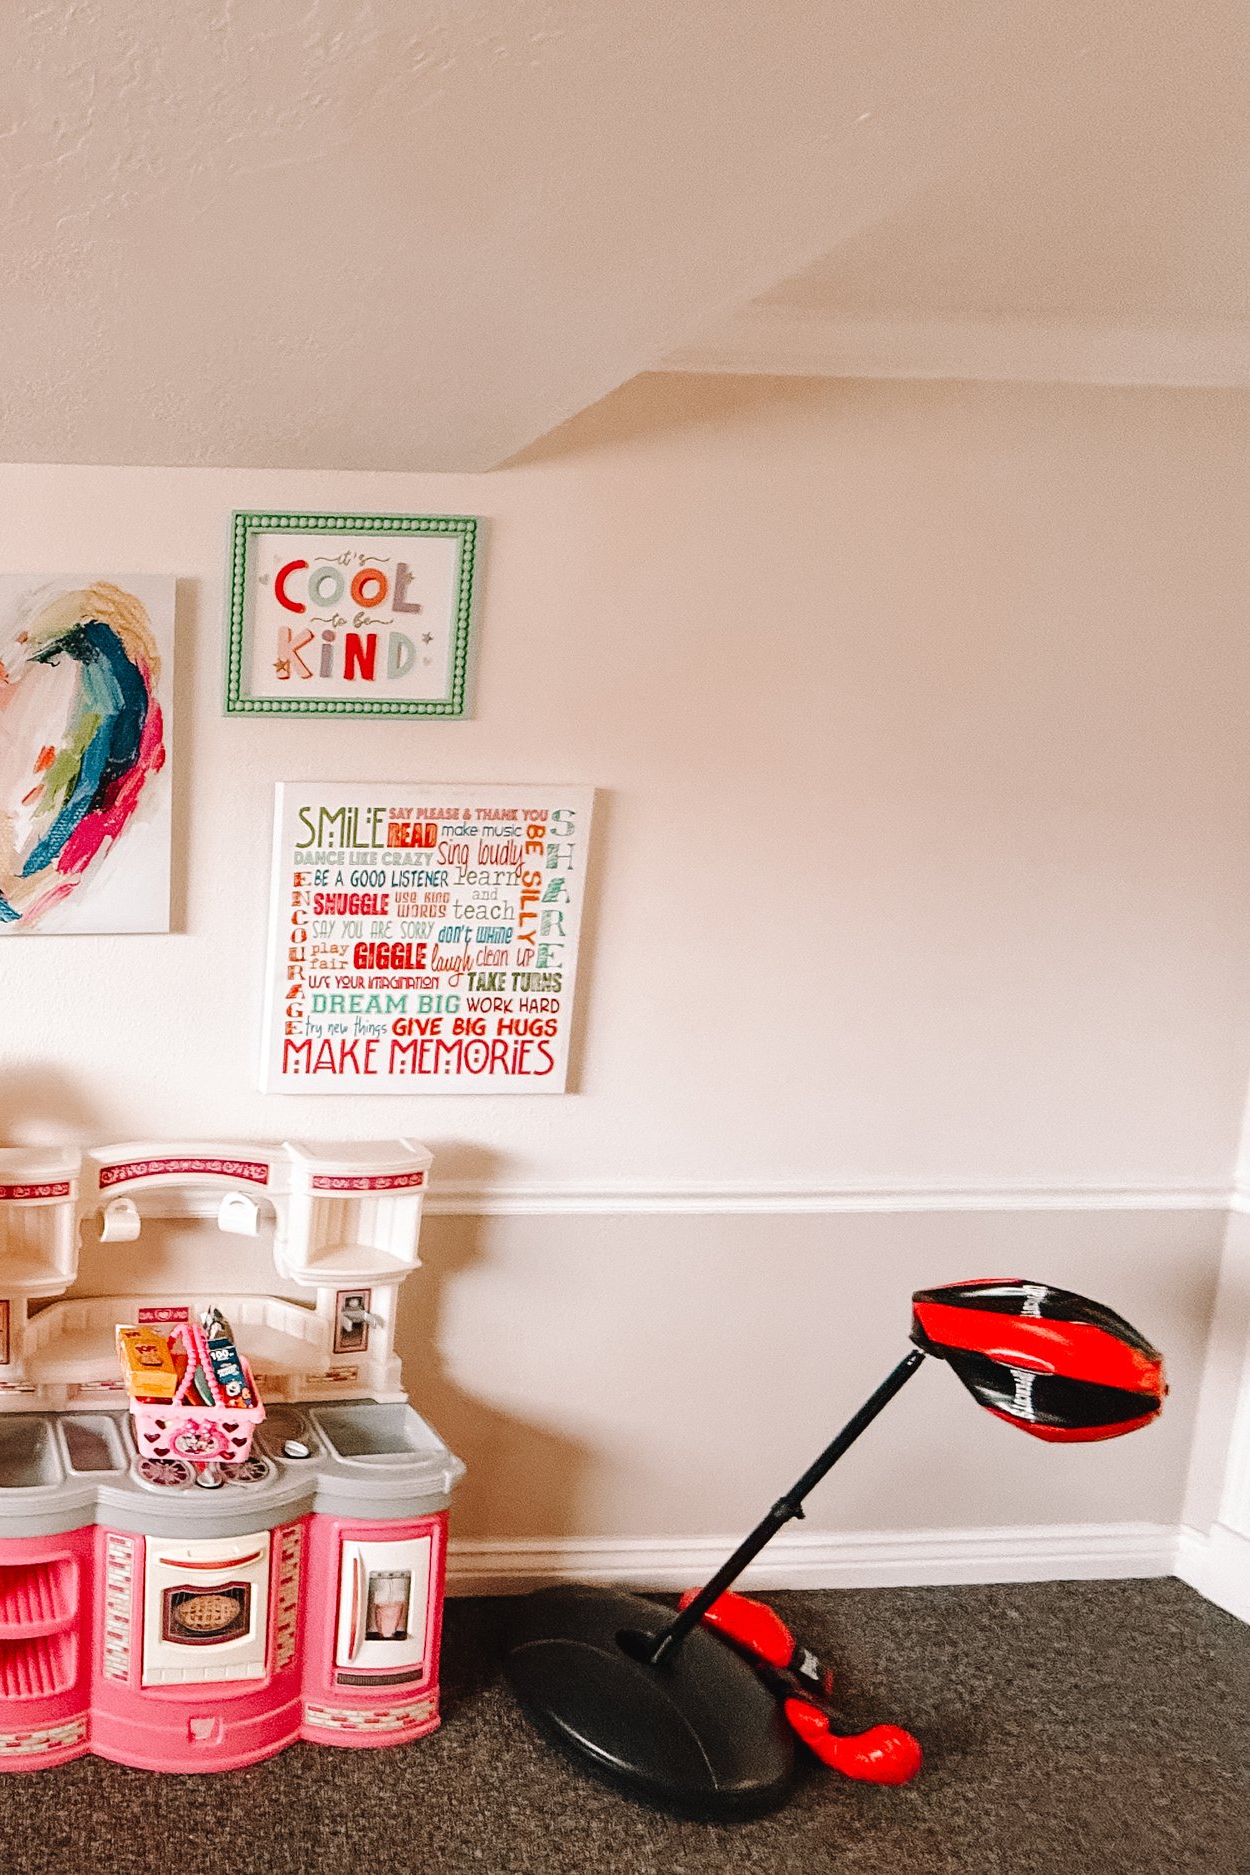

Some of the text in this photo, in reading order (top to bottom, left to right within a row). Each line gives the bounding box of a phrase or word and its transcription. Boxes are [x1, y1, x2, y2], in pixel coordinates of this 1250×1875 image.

[274, 559, 423, 614] COOL
[389, 808, 549, 822] SAY PLEASE & THANK YOU
[387, 823, 438, 848] READ
[441, 822, 522, 838] make music
[293, 851, 434, 866] DANCE LIKE CRAZY
[437, 838, 526, 879] Sing loudly
[314, 869, 449, 887] BE A GOOD LISTENER
[453, 866, 520, 886] learn
[517, 823, 546, 946] BE SILLY
[472, 888, 499, 901] and
[535, 809, 576, 969] SHARE
[313, 892, 390, 916] SNUGGLE
[397, 904, 447, 918] WORDS
[453, 900, 515, 920] teach
[312, 920, 436, 940] SAY YOU ARE SORRY
[438, 925, 473, 943] don't
[285, 872, 312, 1036] ENCOURAGE
[310, 942, 349, 957] play
[353, 942, 428, 970] GIGGLE
[476, 946, 509, 967] clean
[310, 958, 349, 970] fair
[431, 943, 474, 987] laugh
[335, 975, 365, 989] YOUR
[467, 972, 562, 993] TAKE TURNS
[311, 993, 461, 1014] DREAM BIG
[466, 997, 560, 1013] WORK HARD
[305, 1015, 388, 1039] try new things
[392, 1017, 558, 1037] GIVE BIG HUGS
[282, 1038, 380, 1074] MAKE
